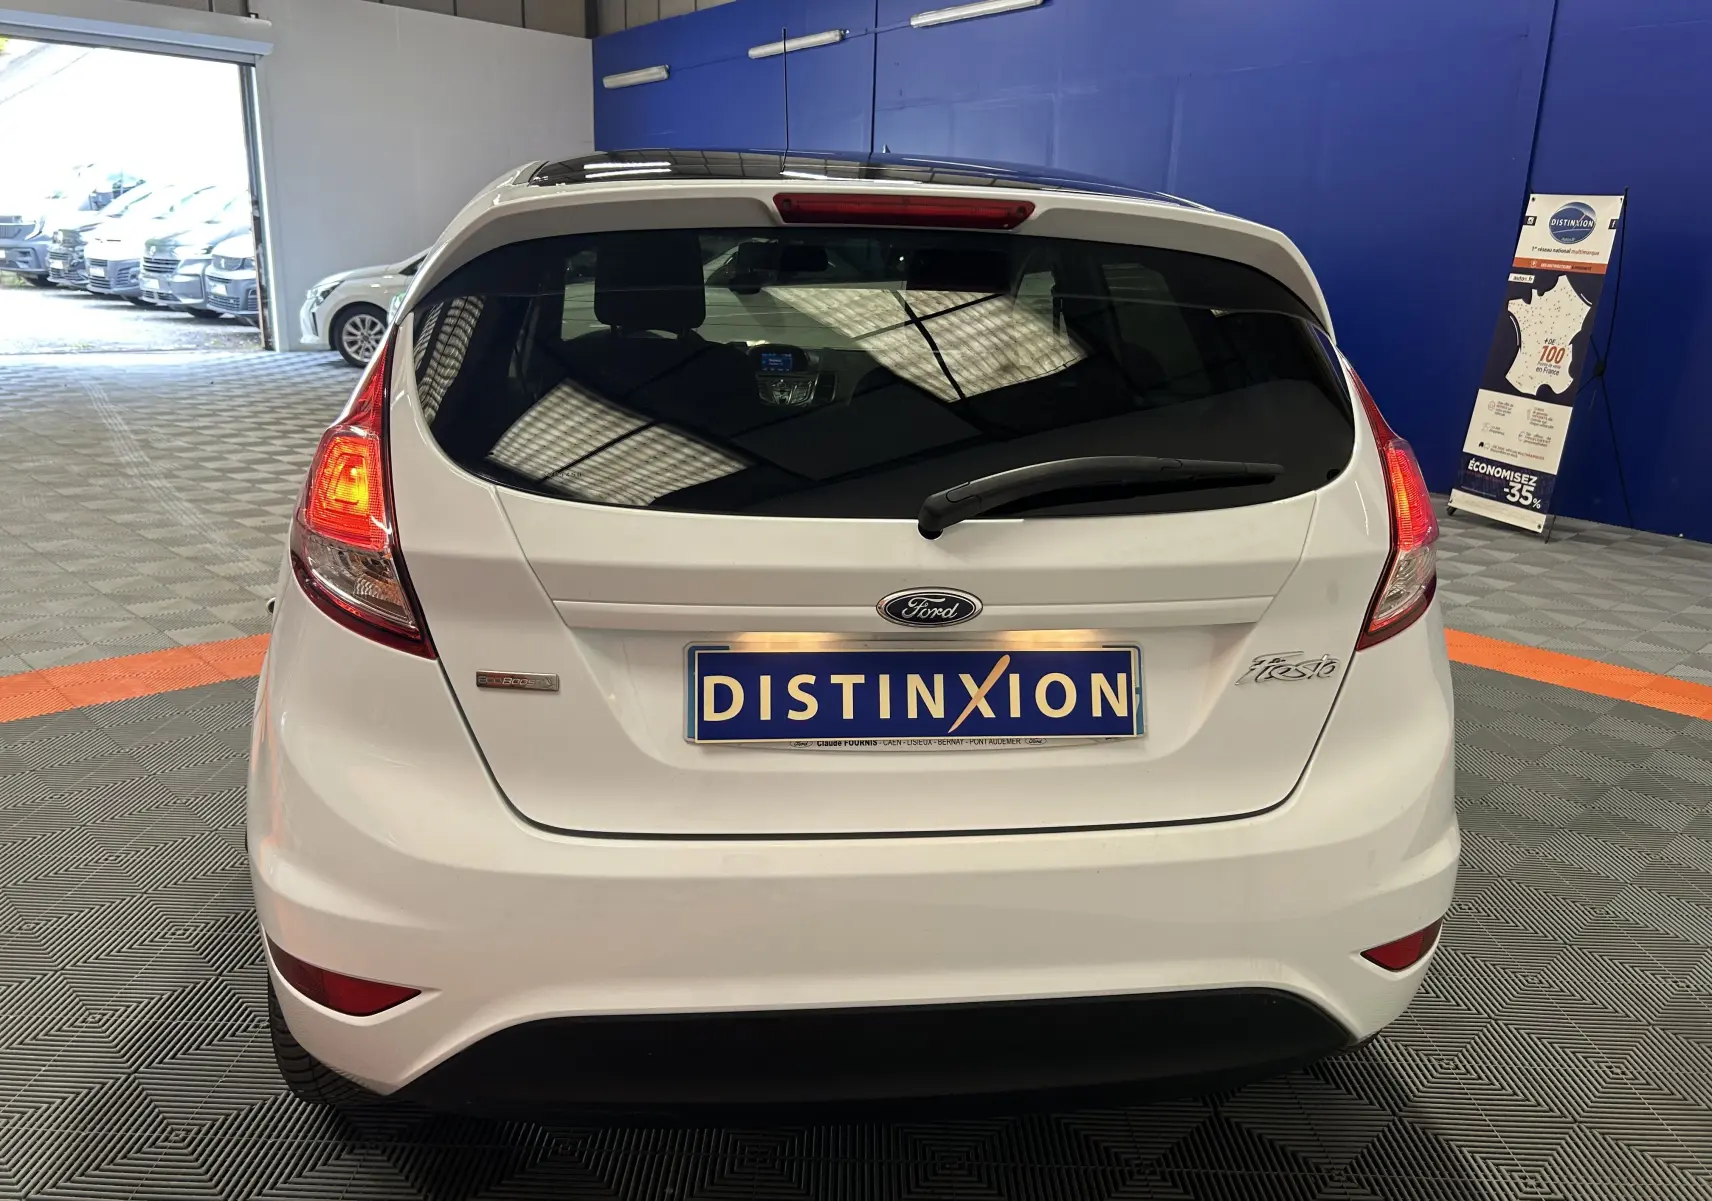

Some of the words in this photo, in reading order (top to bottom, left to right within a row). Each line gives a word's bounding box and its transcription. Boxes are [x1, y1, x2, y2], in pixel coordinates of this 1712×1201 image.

[1550, 216, 1594, 228] DISTINXION
[1540, 345, 1566, 364] 100
[1544, 367, 1560, 376] France
[1467, 458, 1538, 487] ÉCONOMISEZ
[901, 596, 960, 619] Ford
[1234, 650, 1341, 686] Fiesta
[702, 661, 1128, 730] DISTINXION
